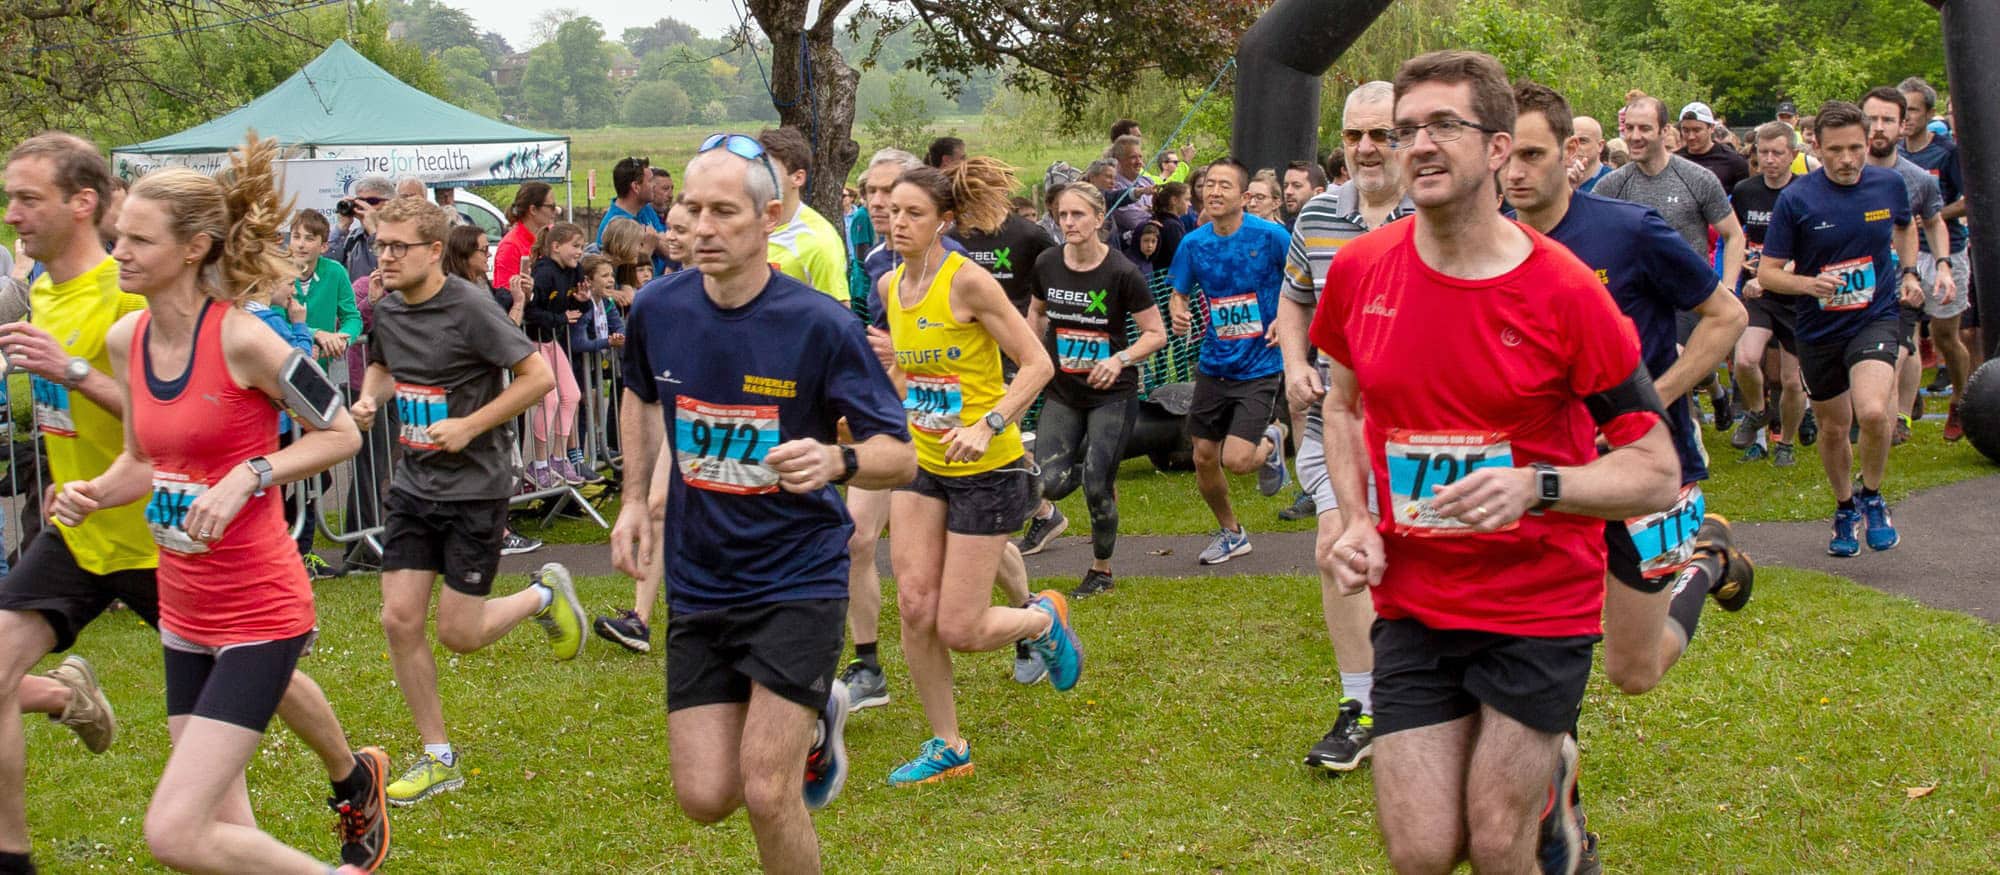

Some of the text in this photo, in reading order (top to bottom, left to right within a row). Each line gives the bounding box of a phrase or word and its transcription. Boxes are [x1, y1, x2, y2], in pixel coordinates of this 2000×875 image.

[1835, 269, 1865, 295] 20
[1219, 304, 1251, 327] 964
[1065, 339, 1100, 361] 779
[742, 383, 797, 398] HARRIERS
[744, 374, 798, 389] WAVERLEY
[691, 418, 760, 466] 972
[147, 486, 189, 532] 06
[1646, 500, 1701, 554] 773
